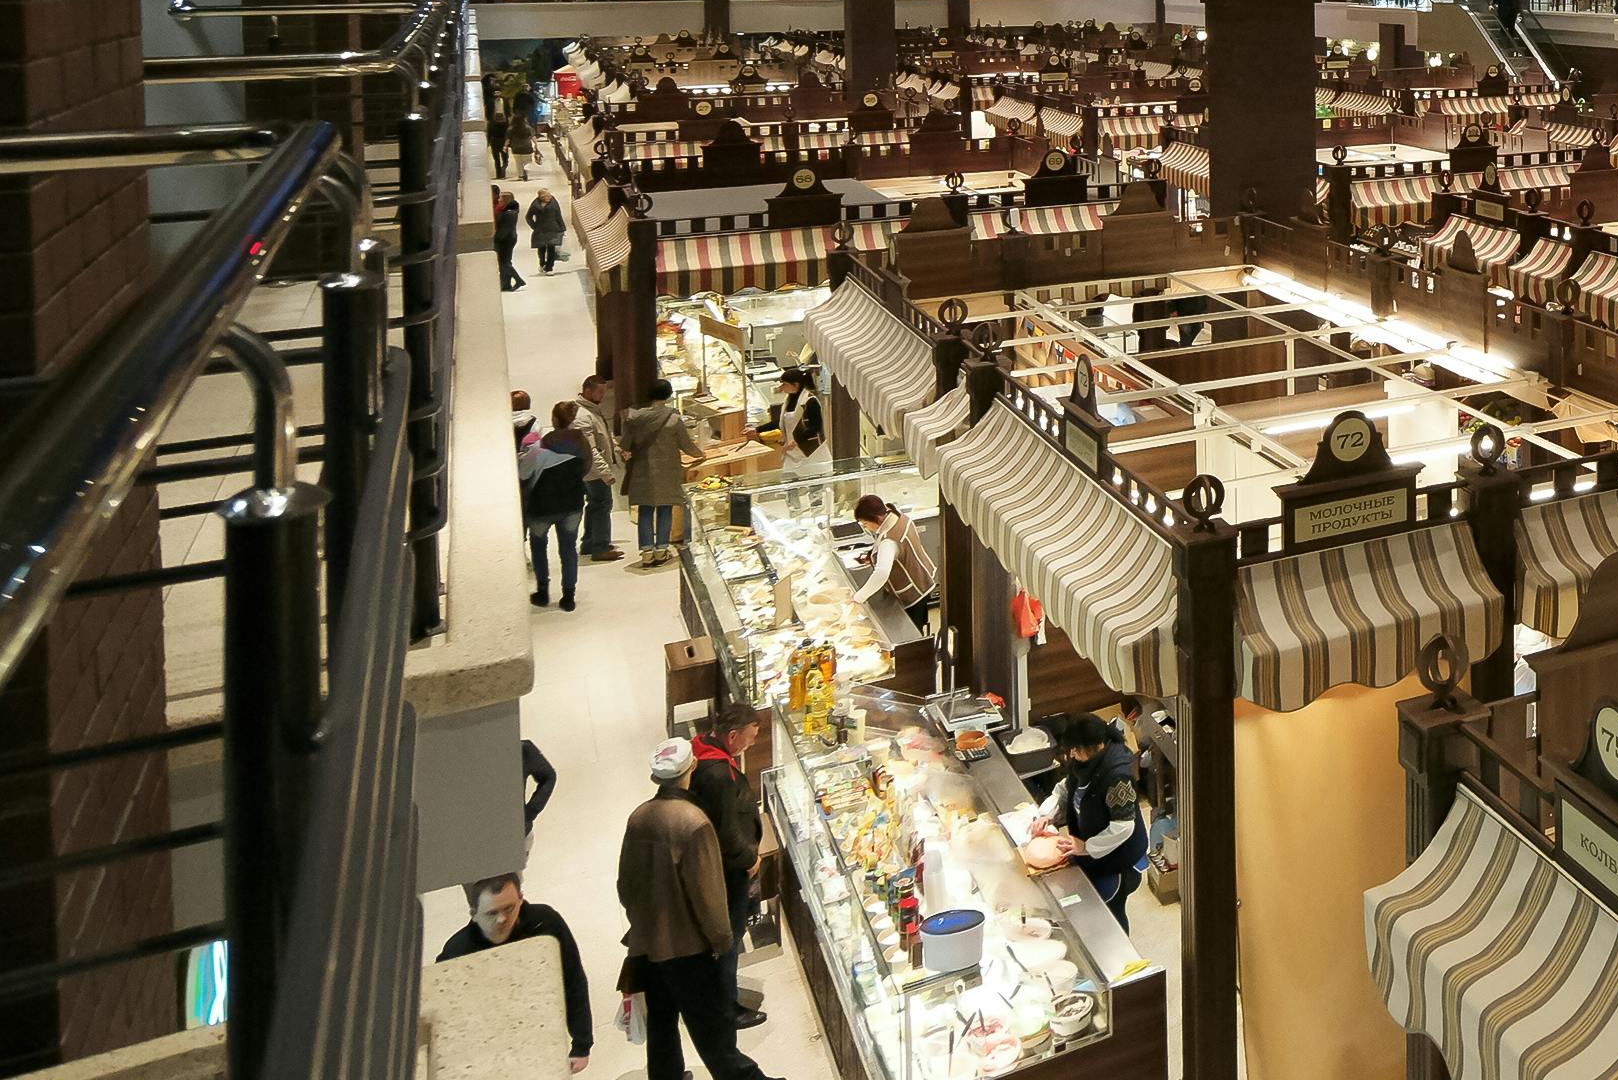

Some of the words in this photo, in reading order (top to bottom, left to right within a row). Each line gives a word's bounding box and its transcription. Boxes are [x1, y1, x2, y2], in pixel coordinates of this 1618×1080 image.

[1048, 157, 1063, 166] 69
[1336, 431, 1365, 450] 72
[1308, 495, 1395, 522] МОЛОЧНЫЕ
[1311, 509, 1393, 535] ПРОДУКТЫ
